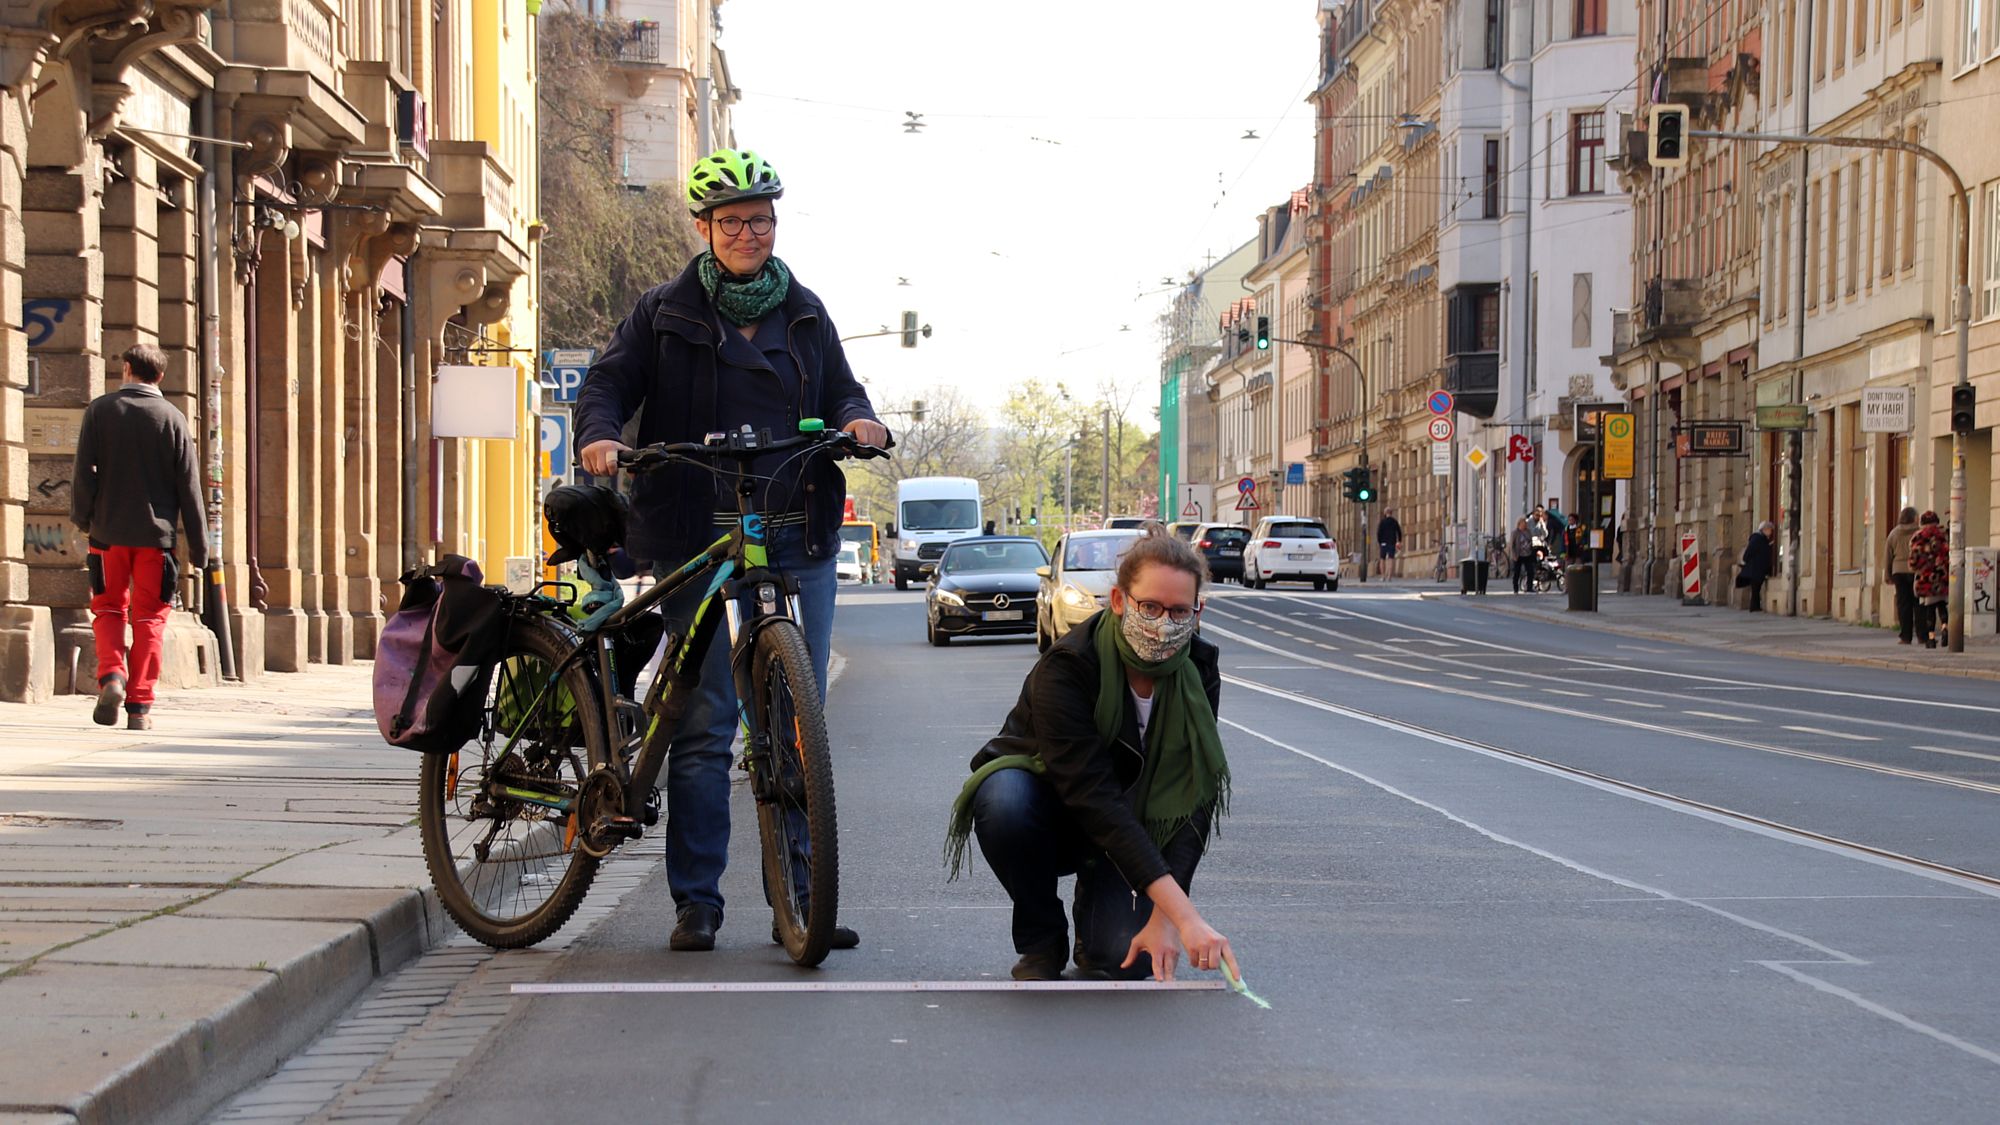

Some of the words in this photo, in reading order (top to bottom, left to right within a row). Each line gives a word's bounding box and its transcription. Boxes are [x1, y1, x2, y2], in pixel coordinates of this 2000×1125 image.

[561, 369, 581, 400] P
[1884, 391, 1904, 401] TOUCH
[1867, 403, 1880, 415] MY
[1882, 402, 1904, 415] HAIR!
[1434, 424, 1449, 435] 30
